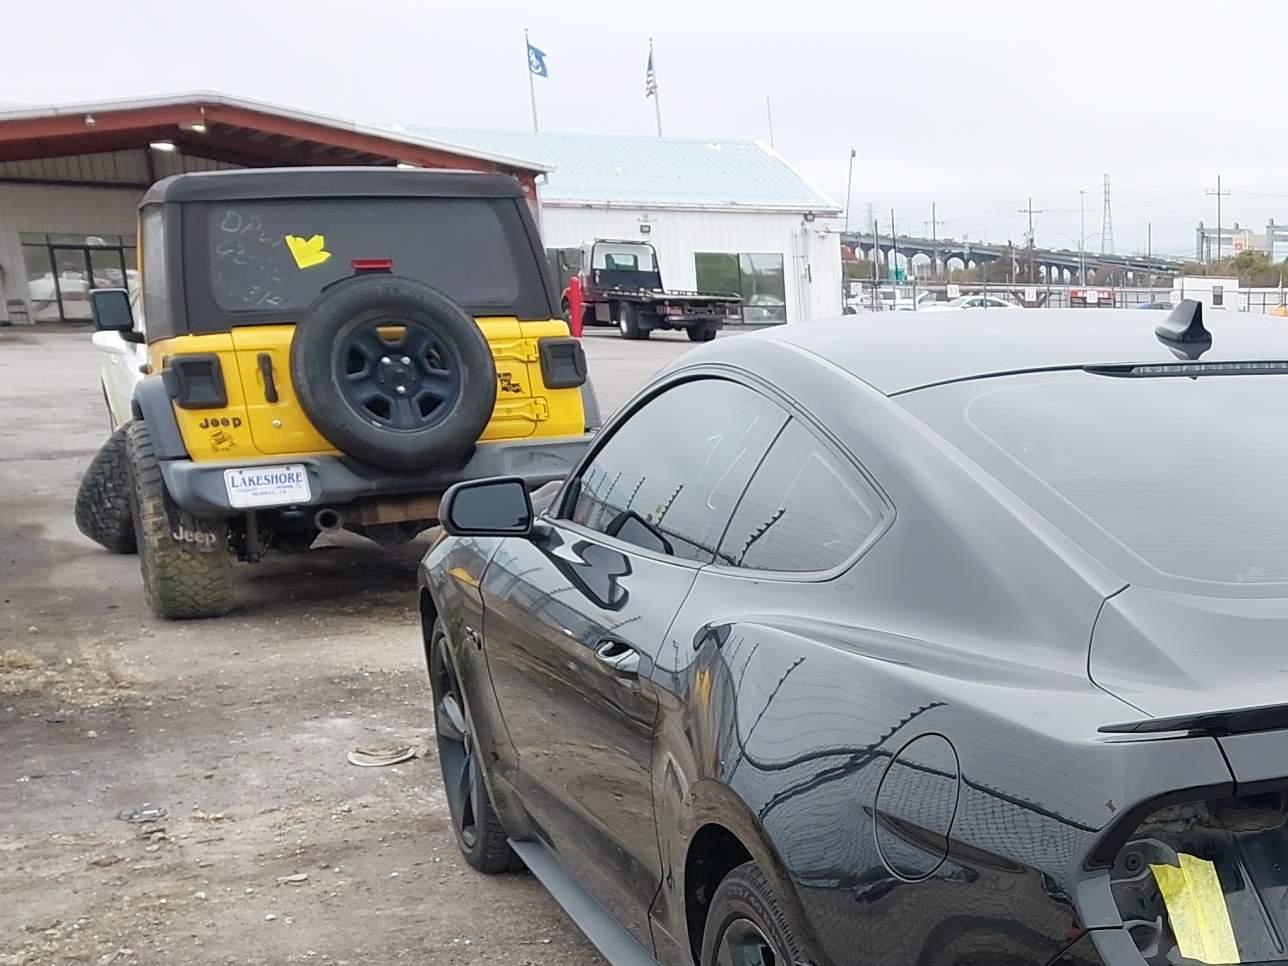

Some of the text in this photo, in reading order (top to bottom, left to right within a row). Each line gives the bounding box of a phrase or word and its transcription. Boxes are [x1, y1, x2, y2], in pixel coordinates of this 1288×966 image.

[199, 417, 242, 429] Jeep
[231, 471, 303, 489] LAKESHORE
[172, 525, 216, 545] Jeep
